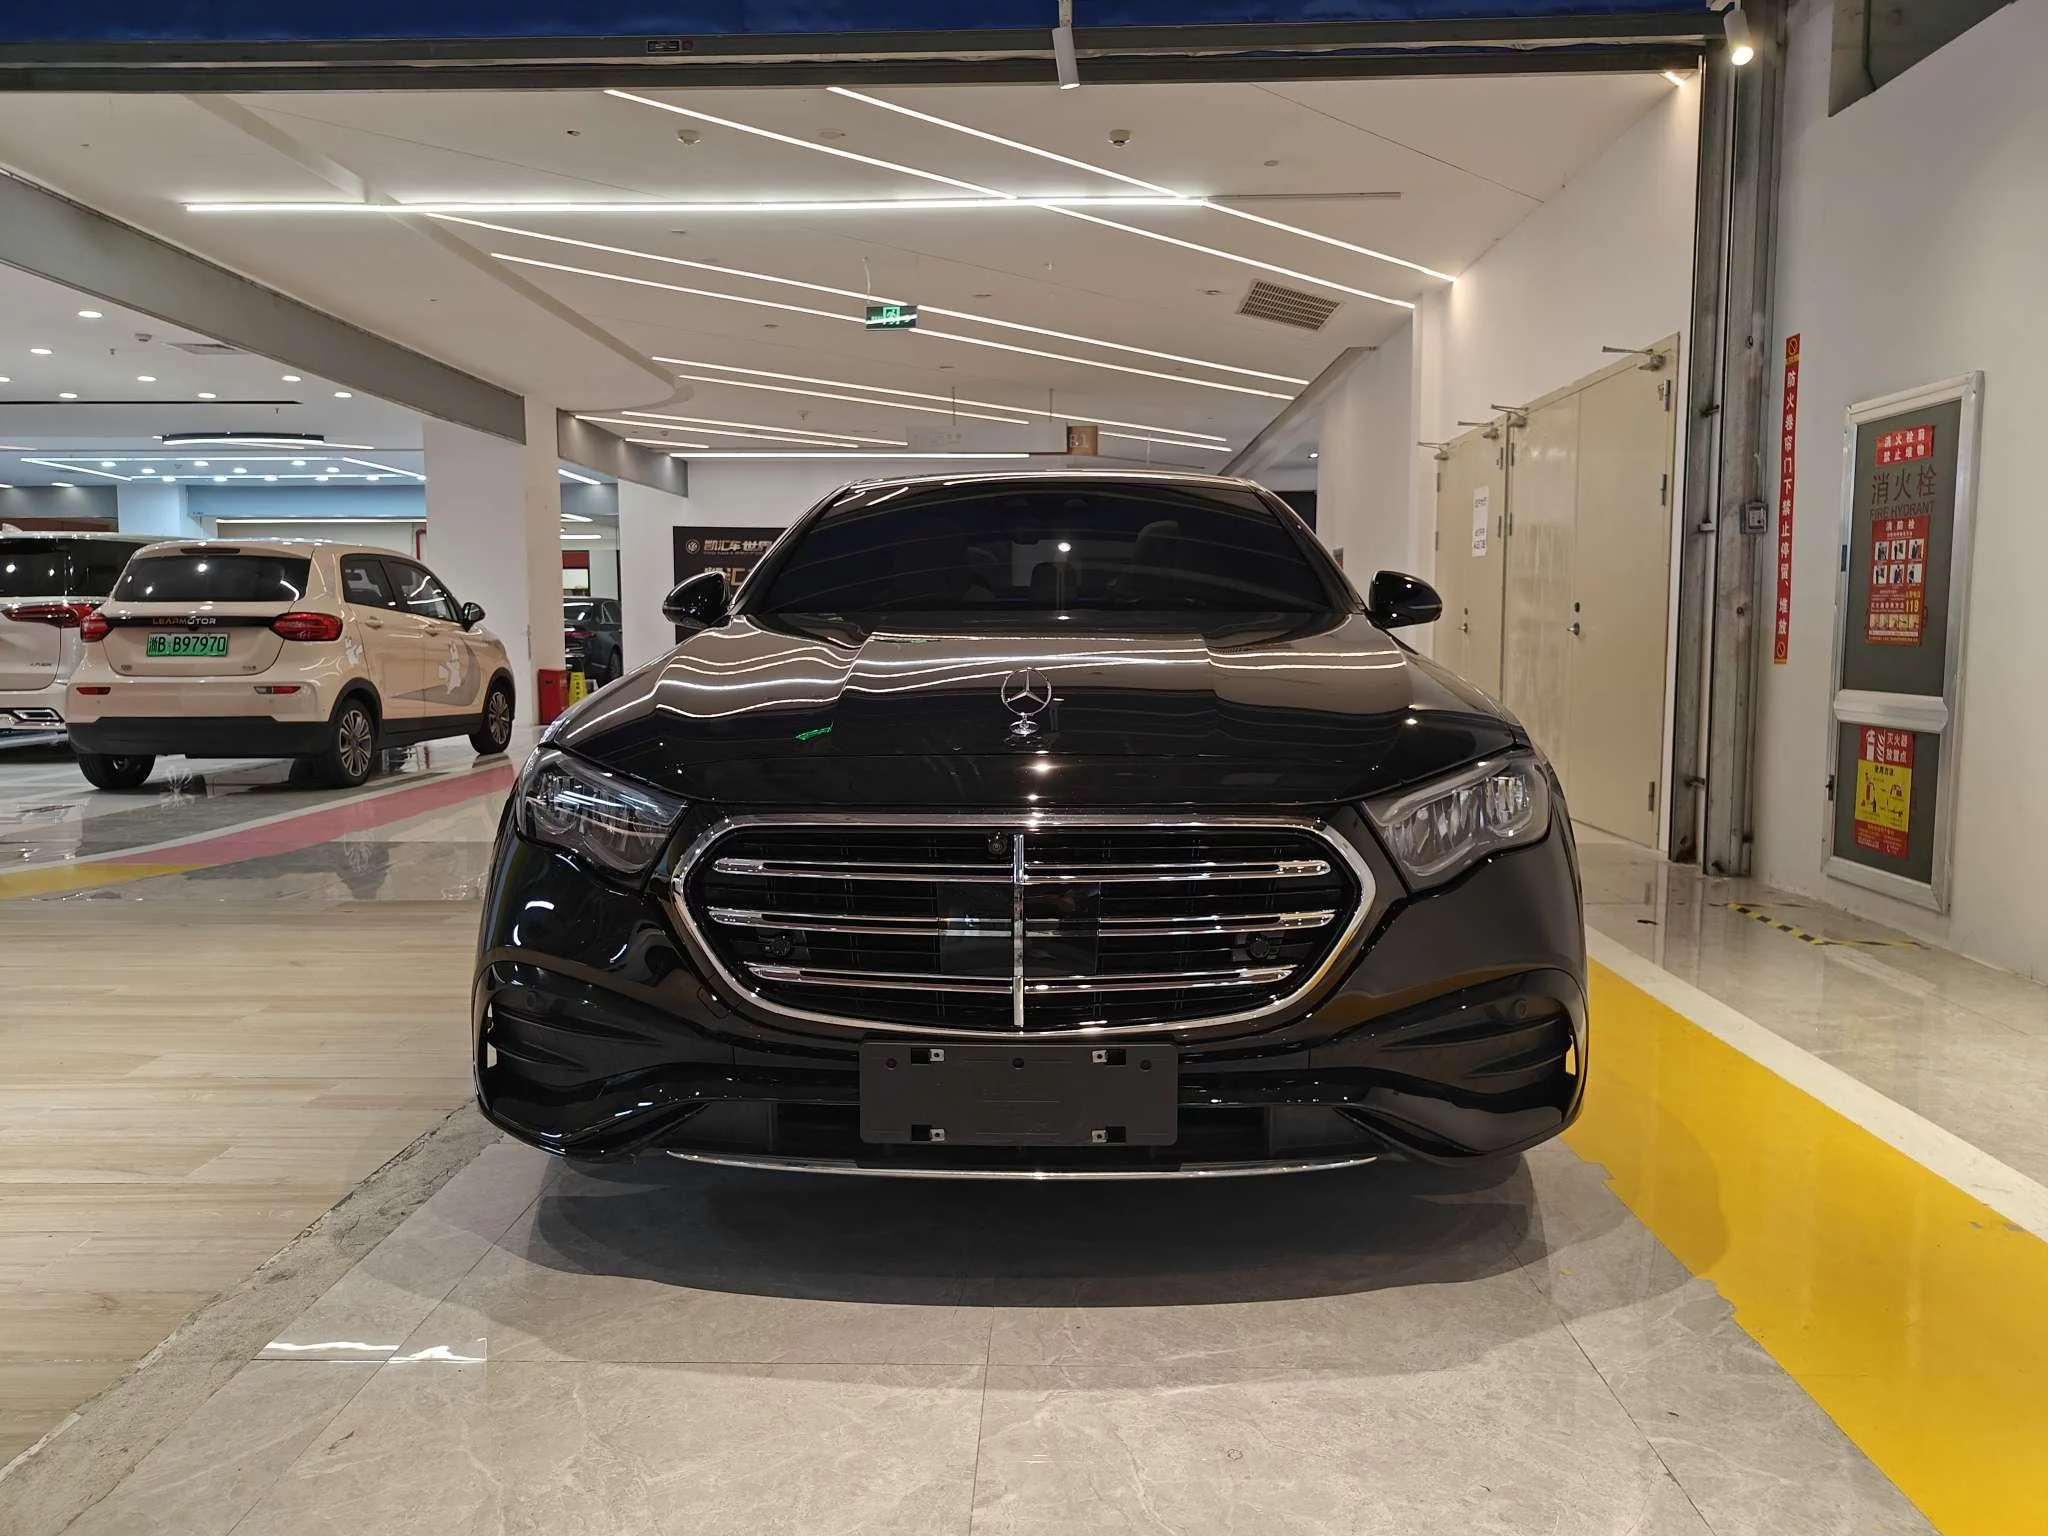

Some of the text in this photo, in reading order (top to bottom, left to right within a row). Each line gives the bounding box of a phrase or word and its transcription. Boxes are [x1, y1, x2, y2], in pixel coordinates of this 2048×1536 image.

[1871, 464, 1936, 505] 消火栓
[1778, 371, 1797, 635] 防火卷帘门下禁止停留、堆放
[1906, 600, 1919, 612] 119
[152, 616, 217, 625] LEAPMOTOR
[173, 636, 227, 653] B97970
[1886, 732, 1908, 747] 灭火器
